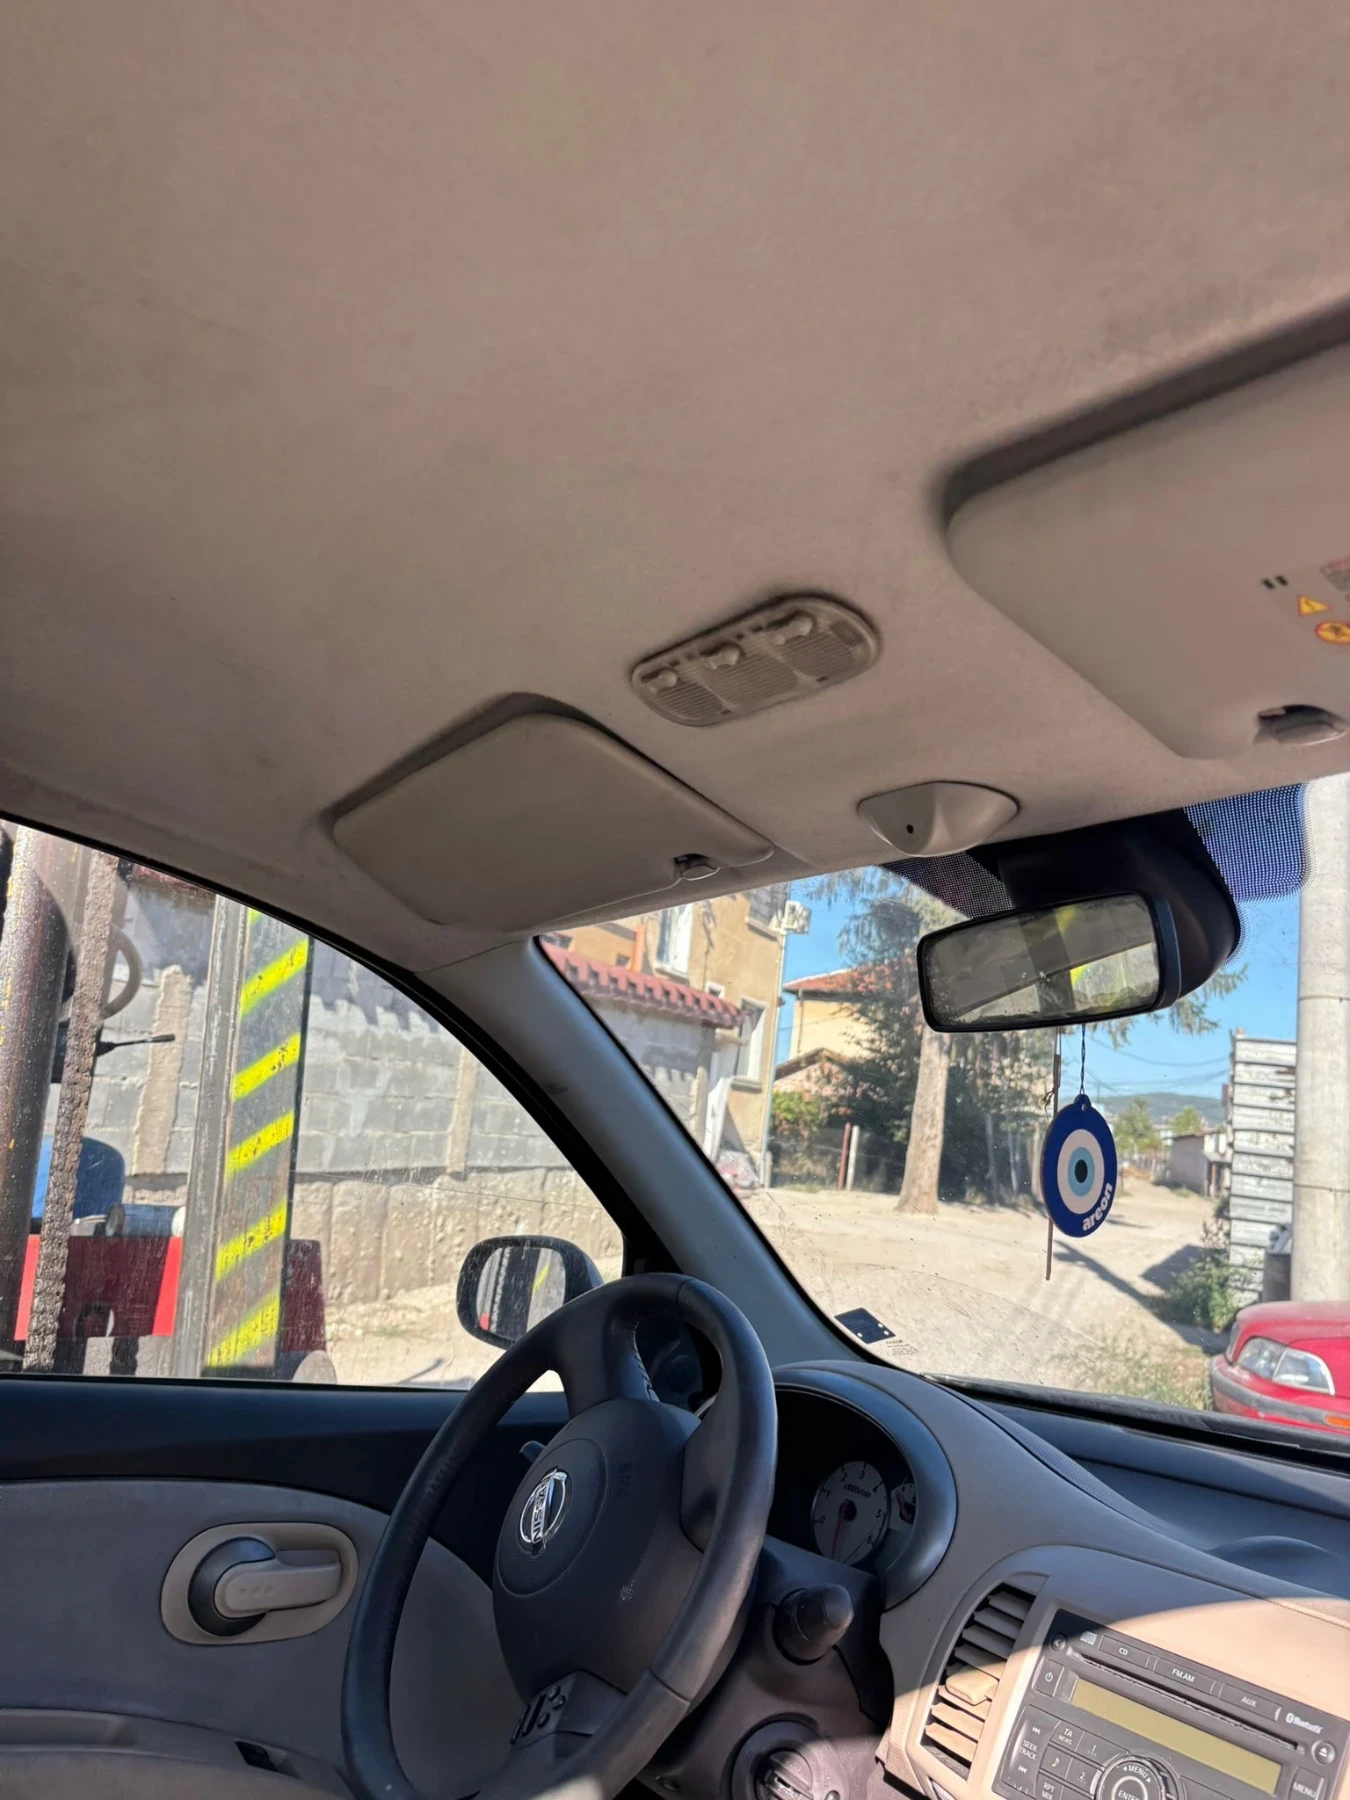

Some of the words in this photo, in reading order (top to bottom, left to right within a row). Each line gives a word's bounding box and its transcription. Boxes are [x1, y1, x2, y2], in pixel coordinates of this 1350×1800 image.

[1082, 1182, 1113, 1231] areon
[841, 1472, 848, 1482] 2
[875, 1508, 882, 1518] 5
[819, 1515, 826, 1525] 0
[1118, 1647, 1129, 1656] CD
[1240, 1696, 1258, 1708] AUX
[1063, 1728, 1073, 1737] TA
[1058, 1734, 1073, 1745] NEWS
[1022, 1739, 1038, 1752] SEEK
[1018, 1746, 1038, 1761] TRACK
[1128, 1764, 1148, 1779] MENU
[1043, 1781, 1055, 1793] RPT
[1292, 1781, 1317, 1799] MENU
[1041, 1789, 1054, 1800] MIX
